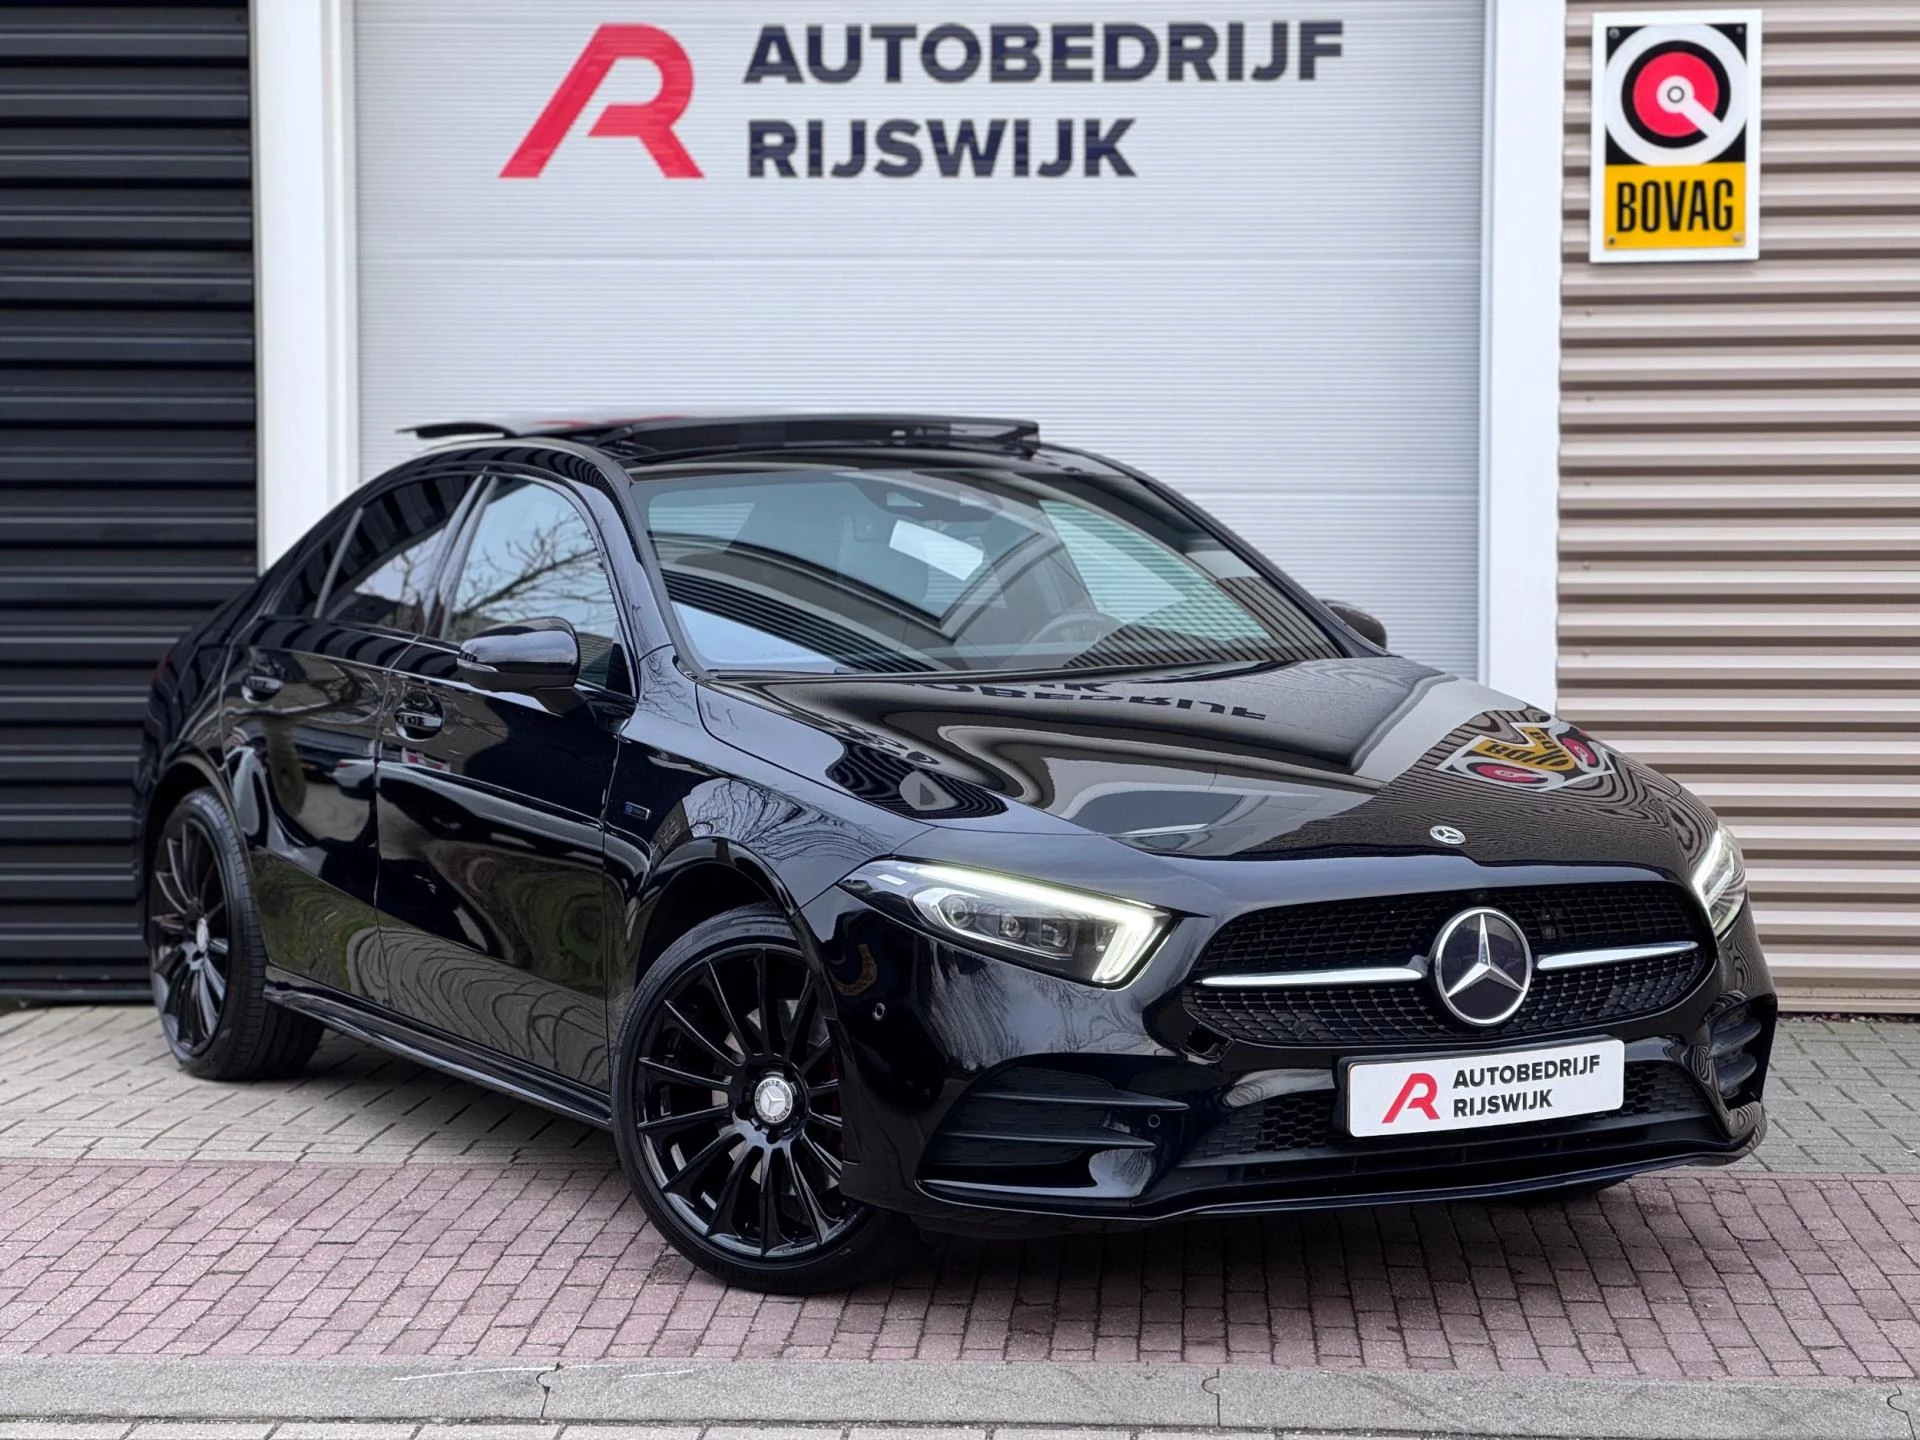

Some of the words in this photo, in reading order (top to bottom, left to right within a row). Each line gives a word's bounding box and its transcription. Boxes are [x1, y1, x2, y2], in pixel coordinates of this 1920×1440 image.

[743, 21, 1343, 84] AUTOBEDRIJF
[747, 118, 1137, 178] RIJSWIJK
[1616, 178, 1734, 233] BOVAG
[1452, 1054, 1601, 1089] AUTOBEDRIJF
[1452, 1089, 1553, 1118] RIJSWIJK
